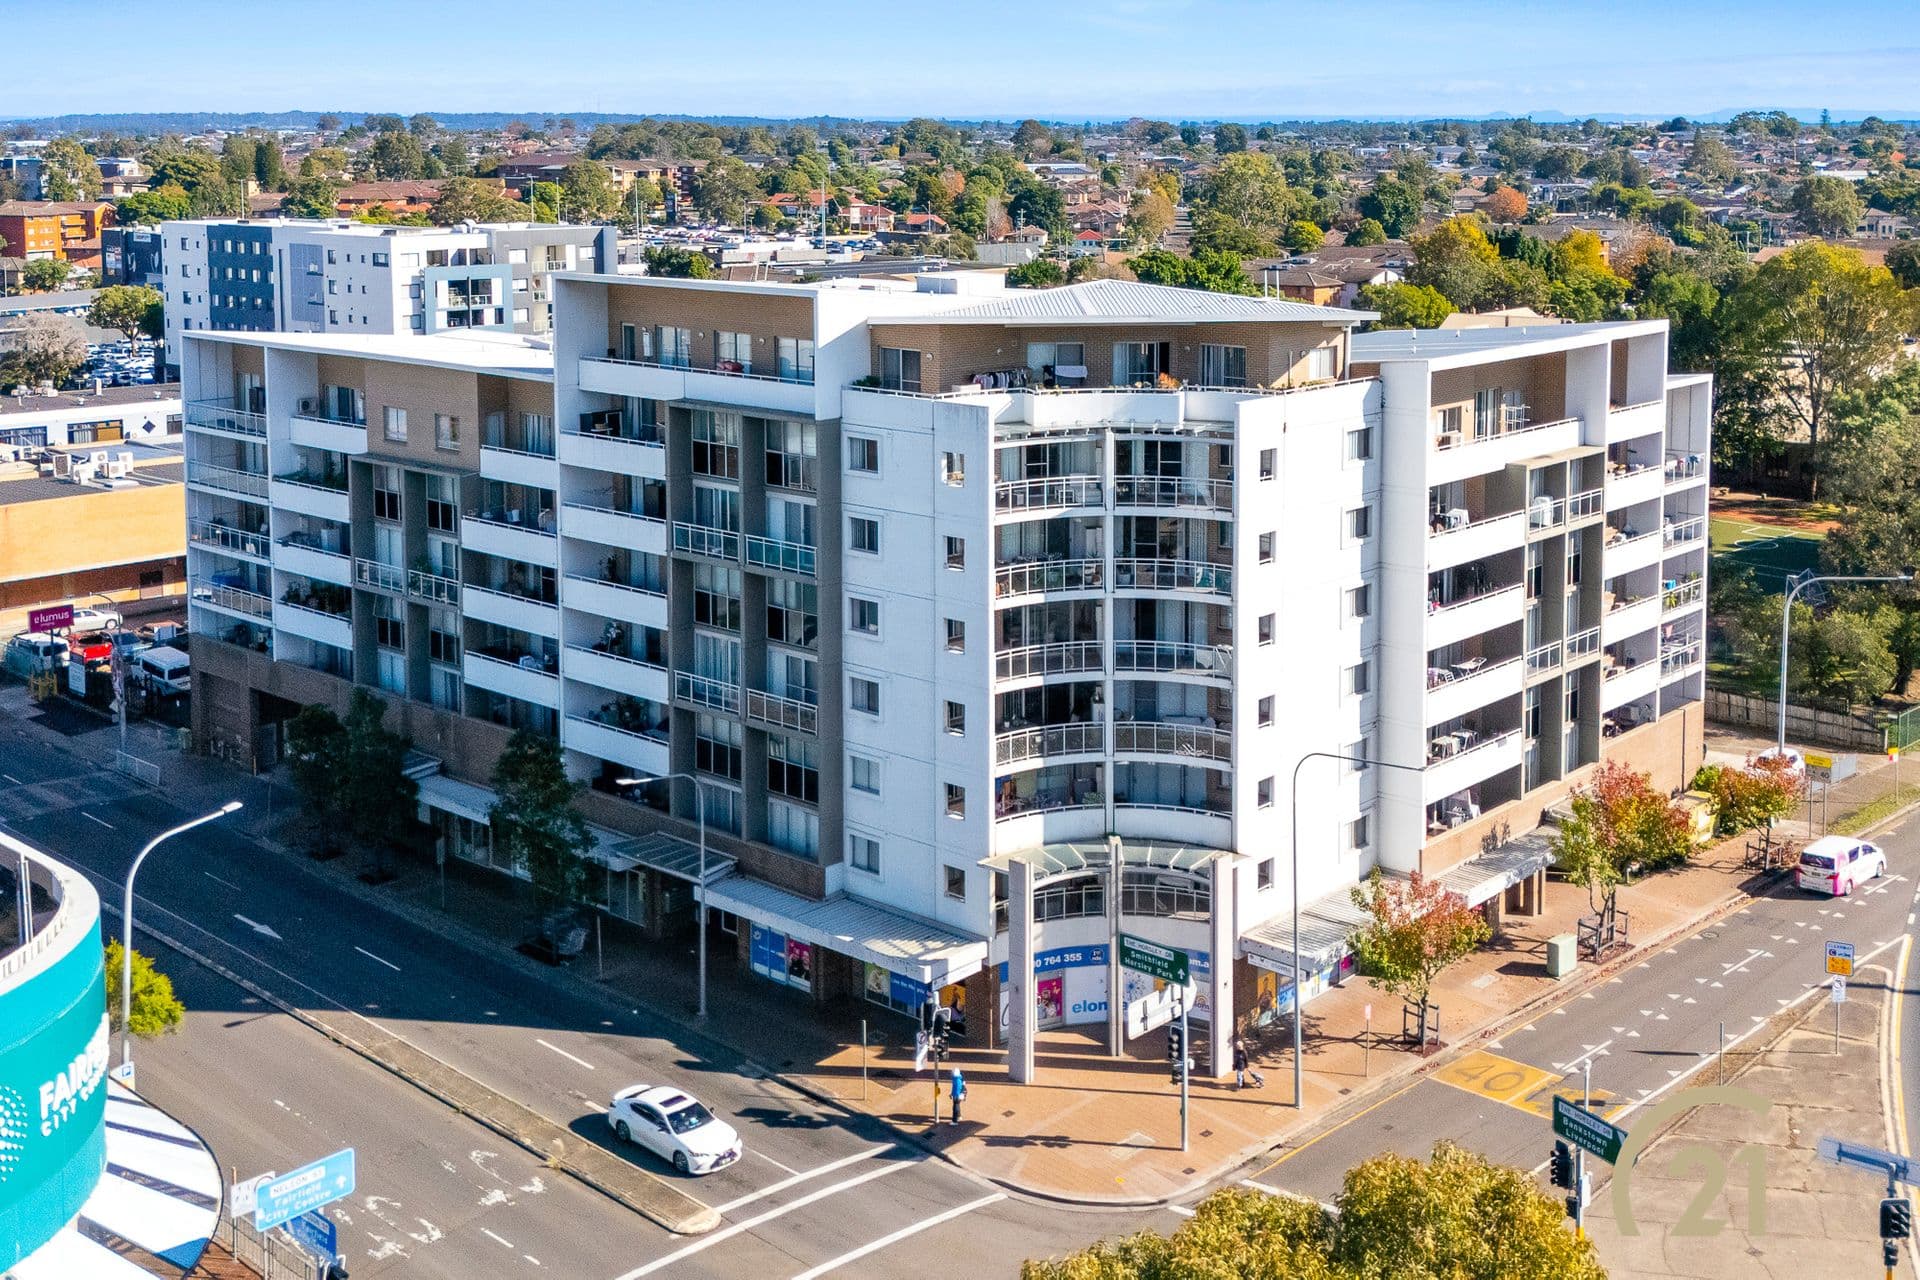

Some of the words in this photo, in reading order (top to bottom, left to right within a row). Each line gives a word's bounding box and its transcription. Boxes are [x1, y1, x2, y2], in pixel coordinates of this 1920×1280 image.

[1044, 955, 1061, 966] 764
[1063, 952, 1082, 963] 355
[1124, 956, 1152, 973] Horsley
[1156, 967, 1174, 979] Park
[1130, 950, 1169, 969] Smithfield
[41, 1098, 77, 1137] CITY
[1562, 1116, 1608, 1148] Bankstown
[1565, 1128, 1605, 1156] Liverpool
[274, 1182, 321, 1208] Fairfield
[293, 1190, 332, 1210] Centre
